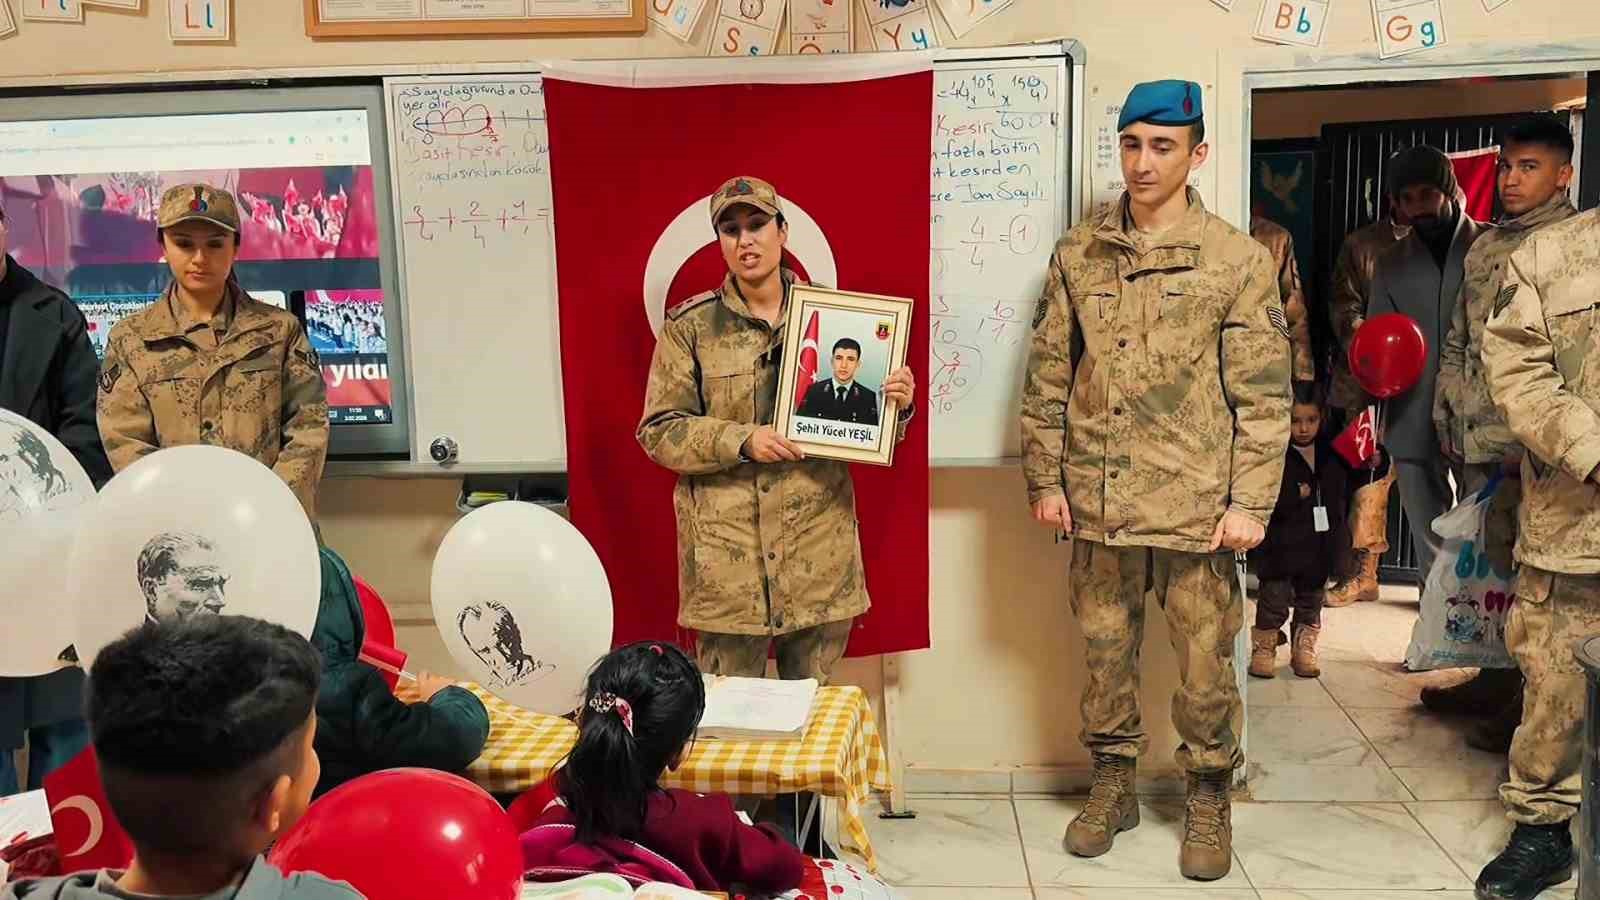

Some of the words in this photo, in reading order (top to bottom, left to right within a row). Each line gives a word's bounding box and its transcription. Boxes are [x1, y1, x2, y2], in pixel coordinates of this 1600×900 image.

[796, 421, 820, 435] Şehit
[822, 423, 847, 438] Yücel
[848, 426, 874, 443] YEŞİL
